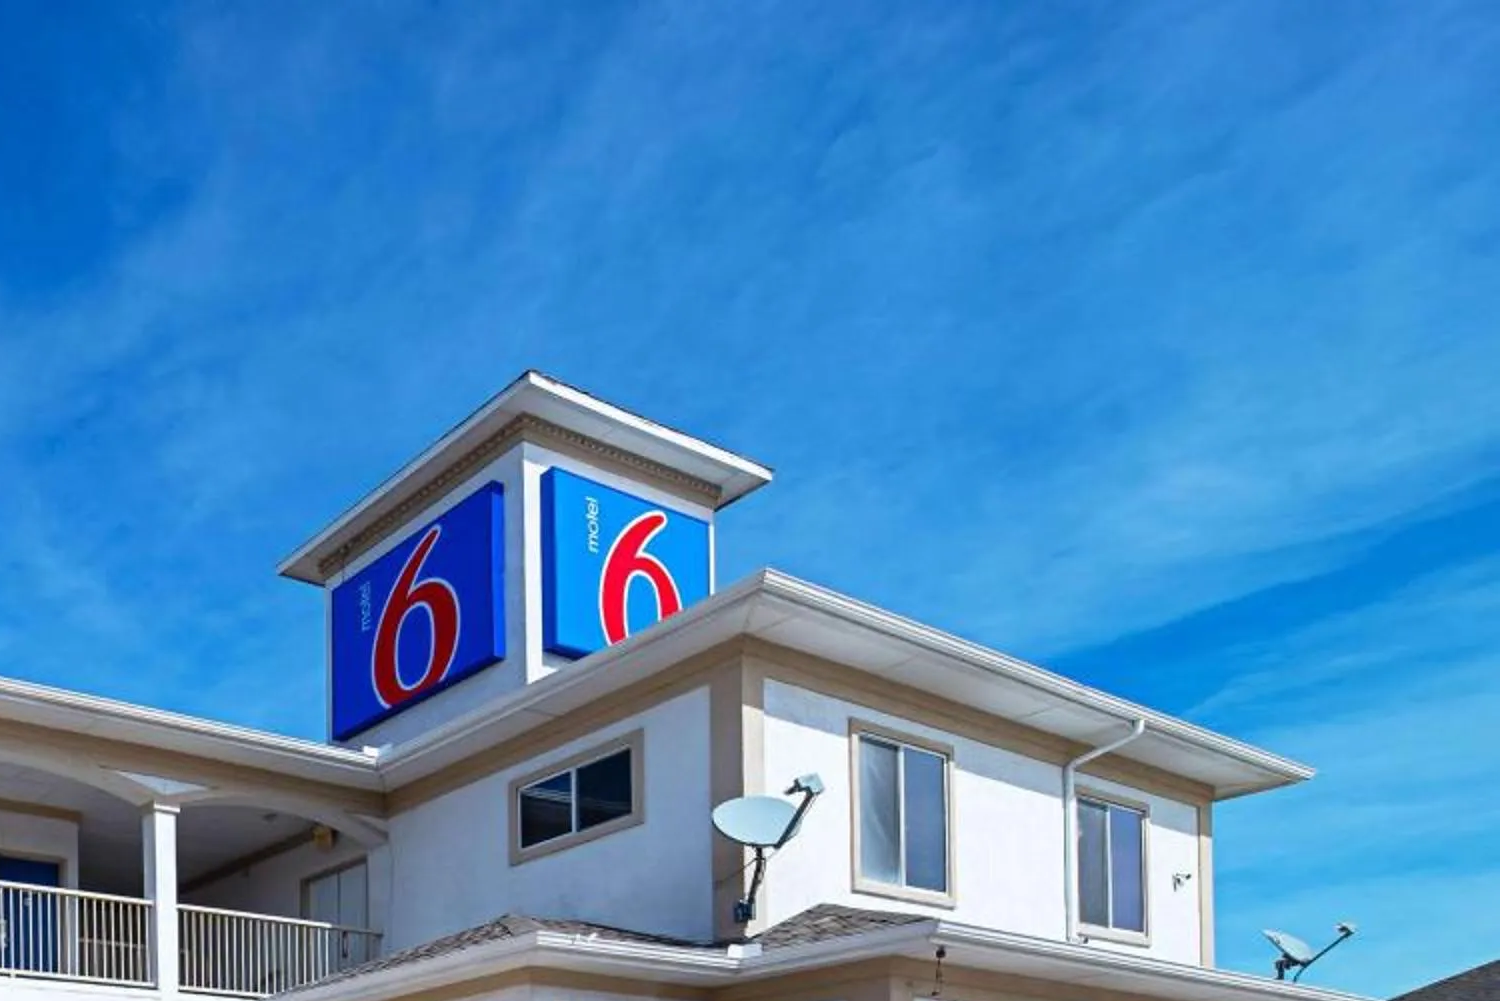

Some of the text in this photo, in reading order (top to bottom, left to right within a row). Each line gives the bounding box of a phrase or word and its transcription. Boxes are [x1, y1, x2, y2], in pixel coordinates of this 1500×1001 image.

[585, 496, 599, 554] motel
[600, 511, 682, 645] 6
[372, 524, 461, 709] 6
